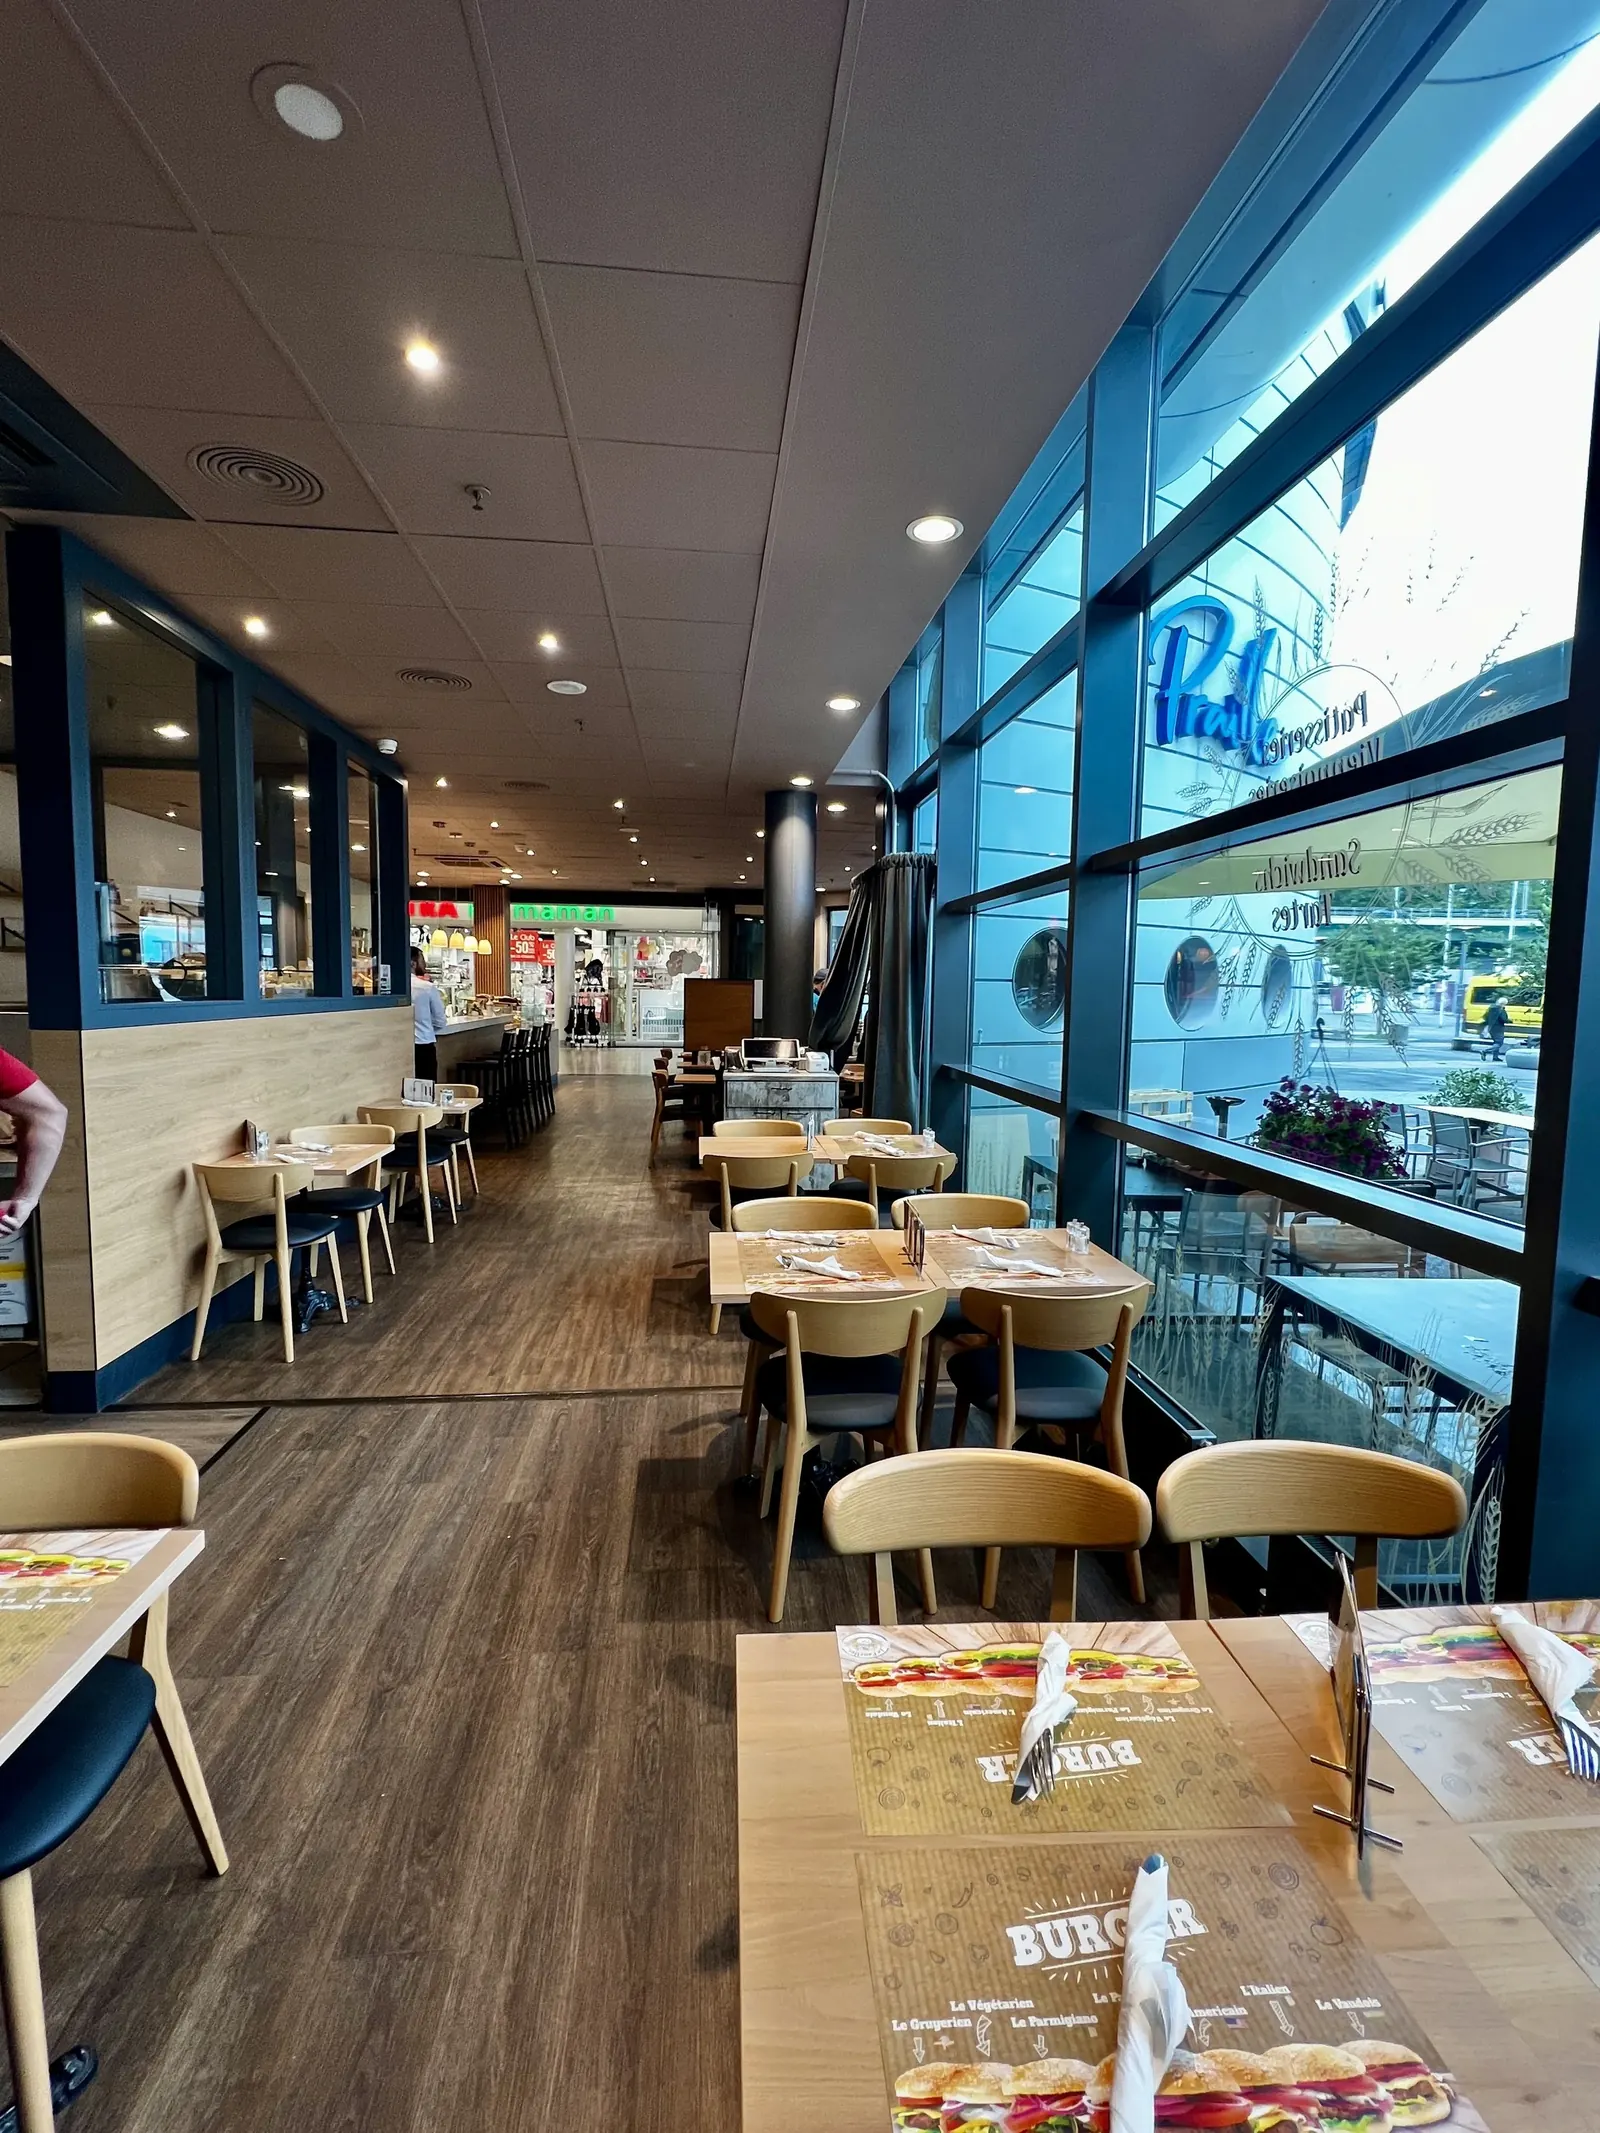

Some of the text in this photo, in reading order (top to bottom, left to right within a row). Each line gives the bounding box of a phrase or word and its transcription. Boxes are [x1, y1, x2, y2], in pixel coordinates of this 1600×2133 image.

[977, 1739, 1142, 1783] BURR
[1006, 1898, 1209, 1966] BURGR
[1240, 1984, 1291, 1996] L'Italien
[950, 2000, 965, 2012] Le
[1315, 1997, 1381, 2011] Le Vaudois
[1191, 2005, 1248, 2018] mericain
[892, 2019, 907, 2031] Le
[1010, 2014, 1098, 2030] Le Parmigiano
